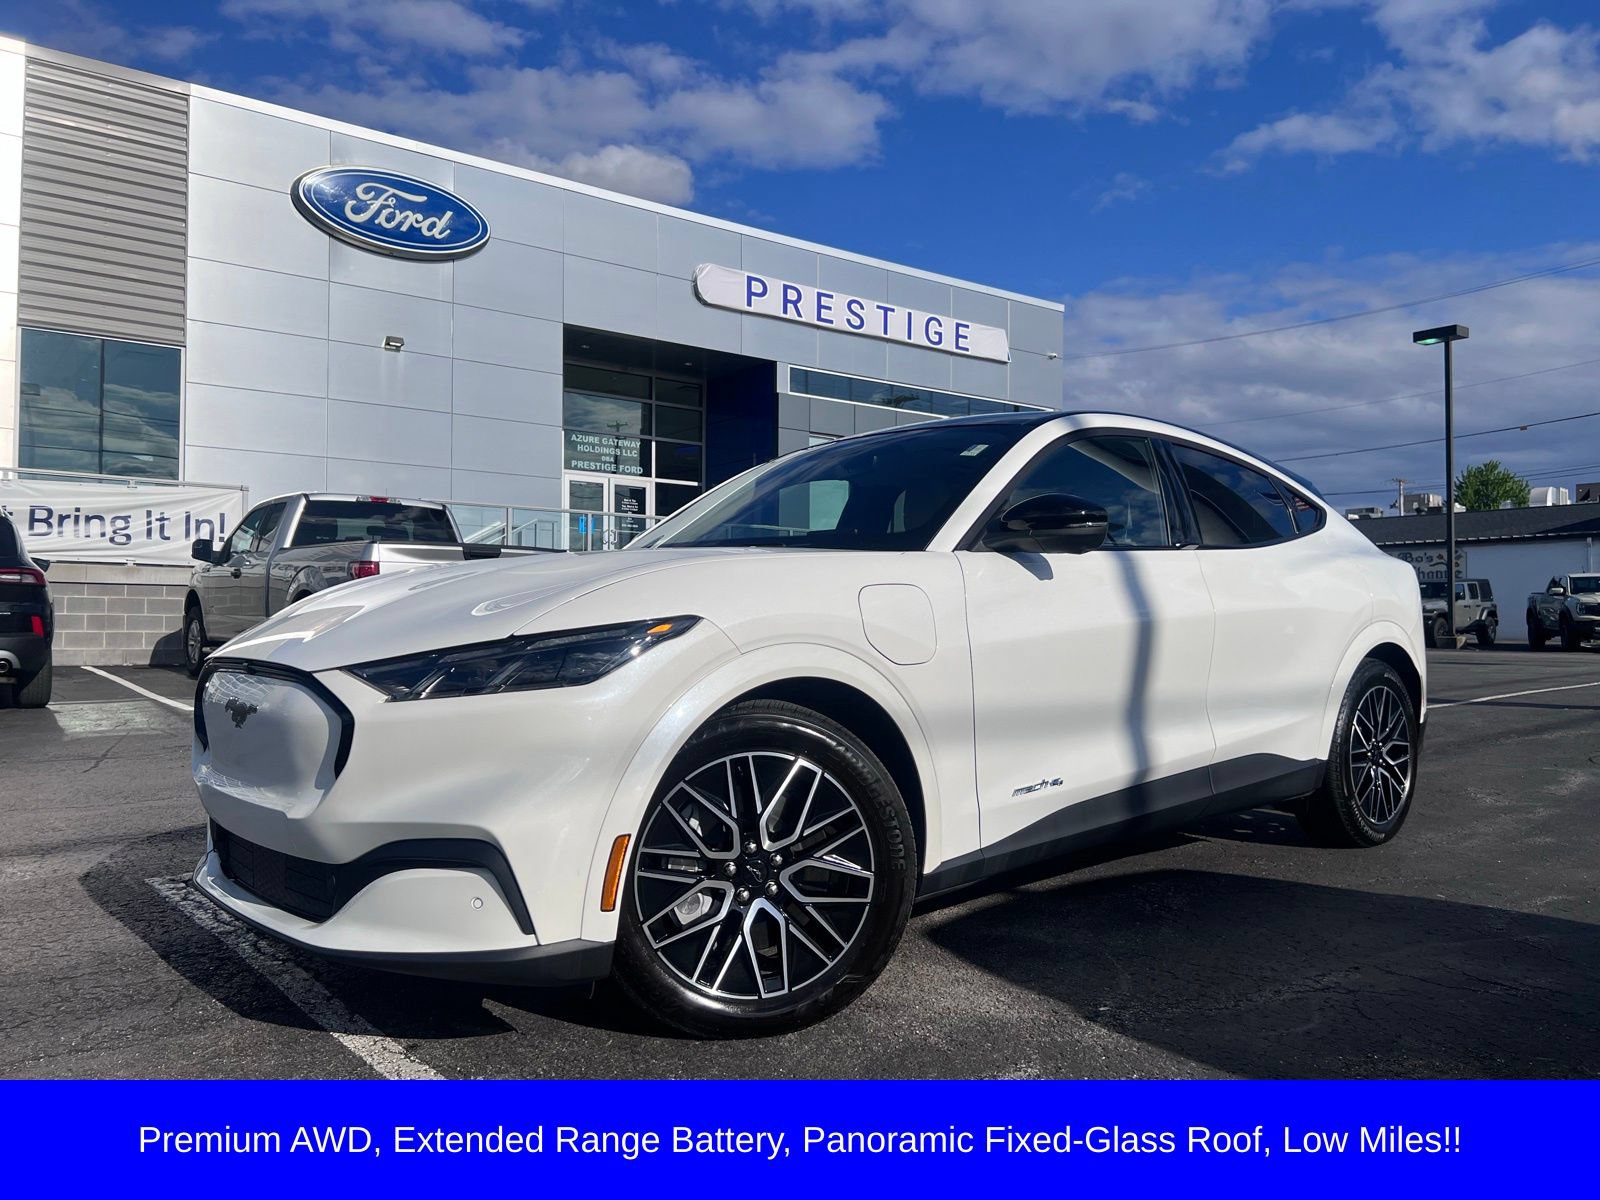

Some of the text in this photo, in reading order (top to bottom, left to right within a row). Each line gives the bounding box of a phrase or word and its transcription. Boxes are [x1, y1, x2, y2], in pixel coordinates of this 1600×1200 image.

[344, 182, 453, 240] Ford
[746, 275, 970, 353] PRESTIGE
[571, 434, 641, 448] AZURE GATEWAY
[577, 444, 638, 457] HOLDINGS LLC
[571, 460, 643, 474] PRESTIGE FORD
[28, 505, 226, 546] Bring It In!
